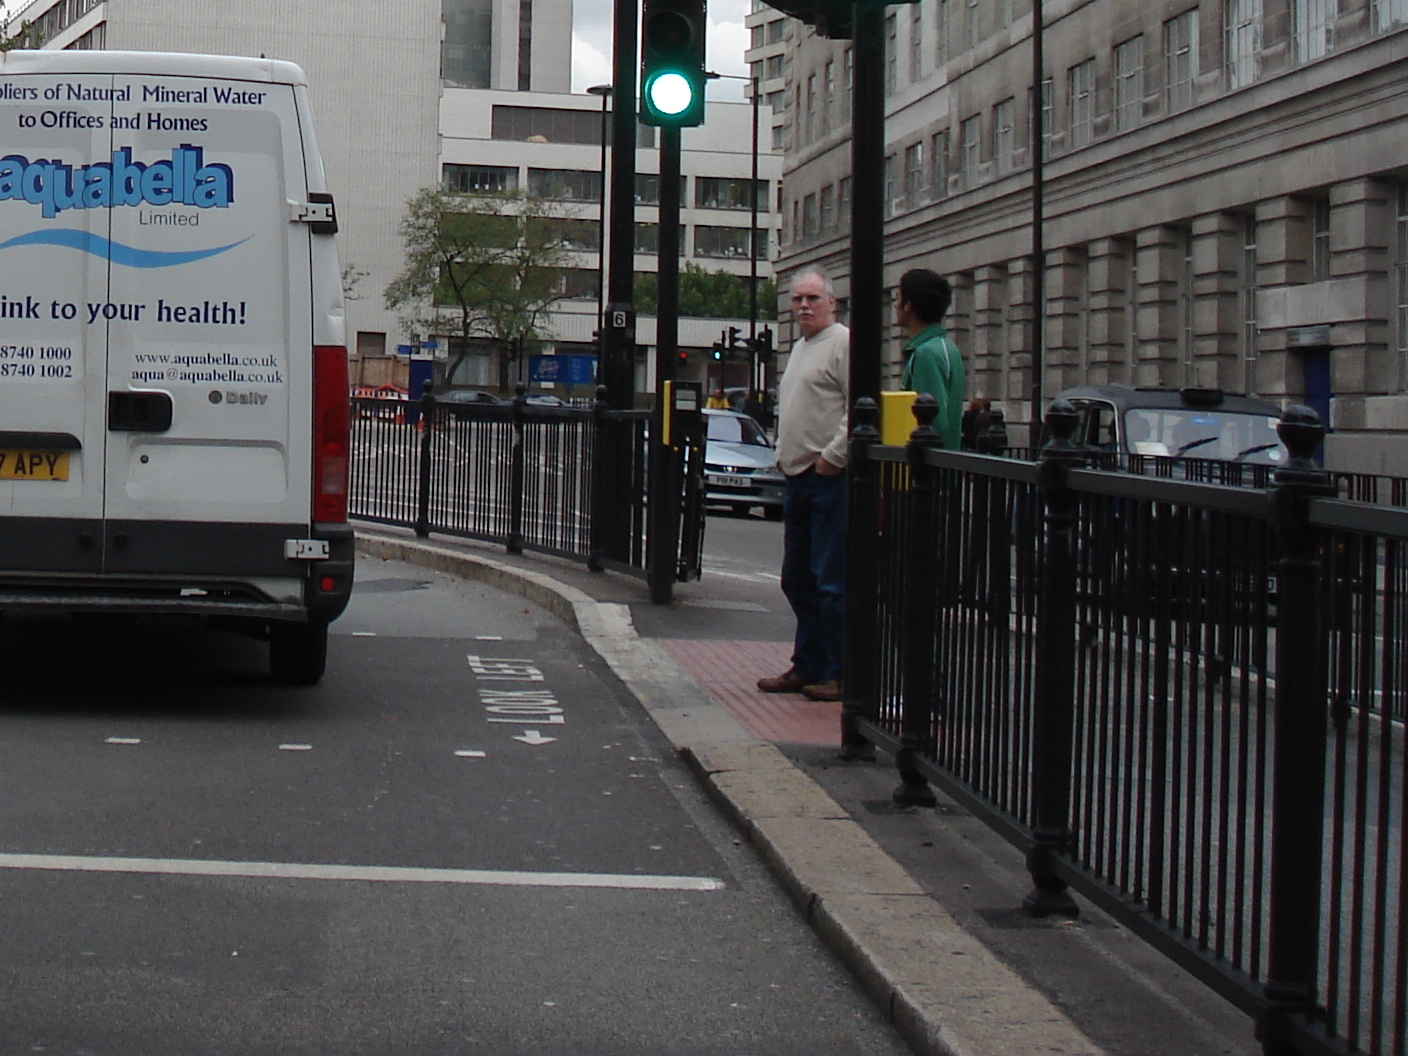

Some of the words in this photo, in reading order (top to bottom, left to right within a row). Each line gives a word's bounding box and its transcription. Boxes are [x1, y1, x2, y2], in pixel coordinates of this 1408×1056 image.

[44, 84, 63, 100] of
[66, 84, 130, 102] Natural
[142, 85, 207, 103] Mineral
[213, 87, 266, 105] Water
[19, 113, 36, 128] to
[41, 110, 103, 129] Offices
[110, 113, 140, 130] and
[147, 113, 208, 131] Homes
[139, 210, 199, 226] Limited
[51, 300, 76, 319] to
[87, 302, 145, 324] your
[158, 299, 246, 325] health!
[615, 313, 624, 326] 6
[0, 346, 34, 359] 8740
[39, 347, 71, 360] 1000
[135, 353, 277, 368] www.aquabella.co.uk
[1, 364, 35, 377] 8740
[40, 365, 72, 378] 1002
[131, 368, 284, 384] aqua@aquabella.co.uk
[14, 452, 59, 476] APY
[467, 655, 545, 681] LEFT
[478, 689, 566, 724] LOOK
